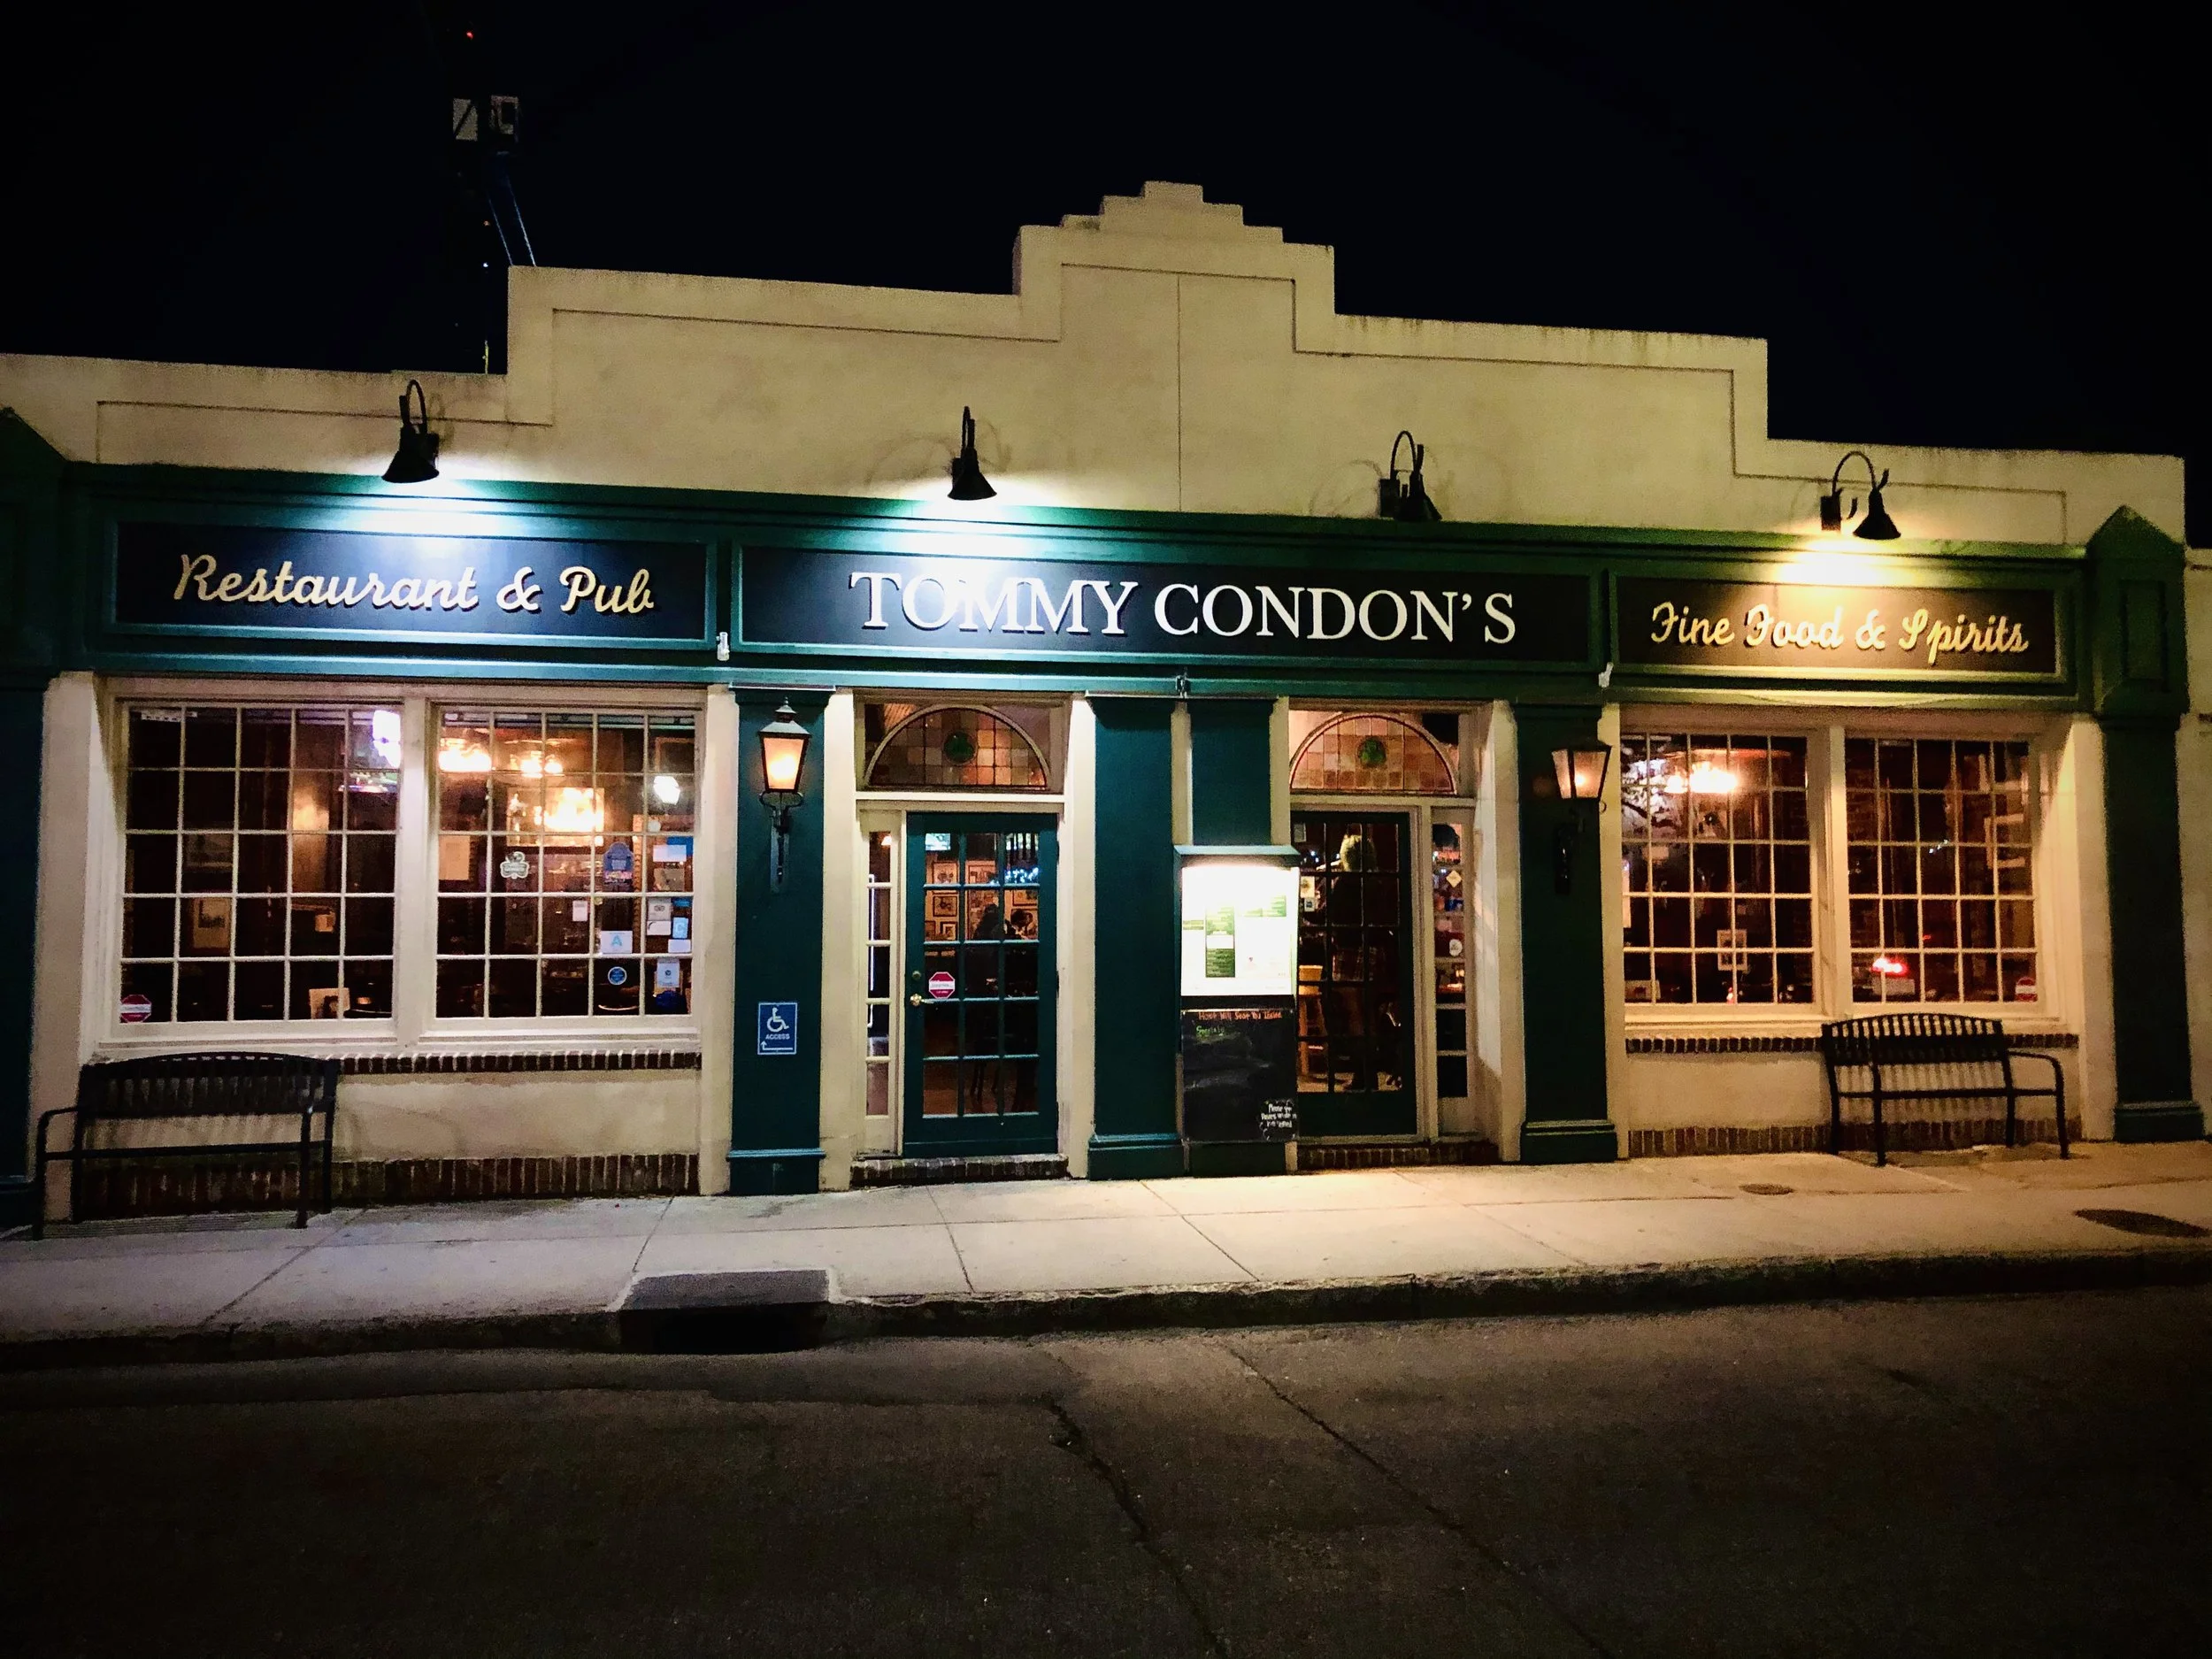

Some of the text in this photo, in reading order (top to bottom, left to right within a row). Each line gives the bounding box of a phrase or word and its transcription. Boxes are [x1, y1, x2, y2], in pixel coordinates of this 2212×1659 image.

[174, 554, 654, 613] Restaurant & Pub
[849, 572, 1516, 644] TOMMY CONDON'S
[1651, 601, 2028, 664] Fine Food & Spirits
